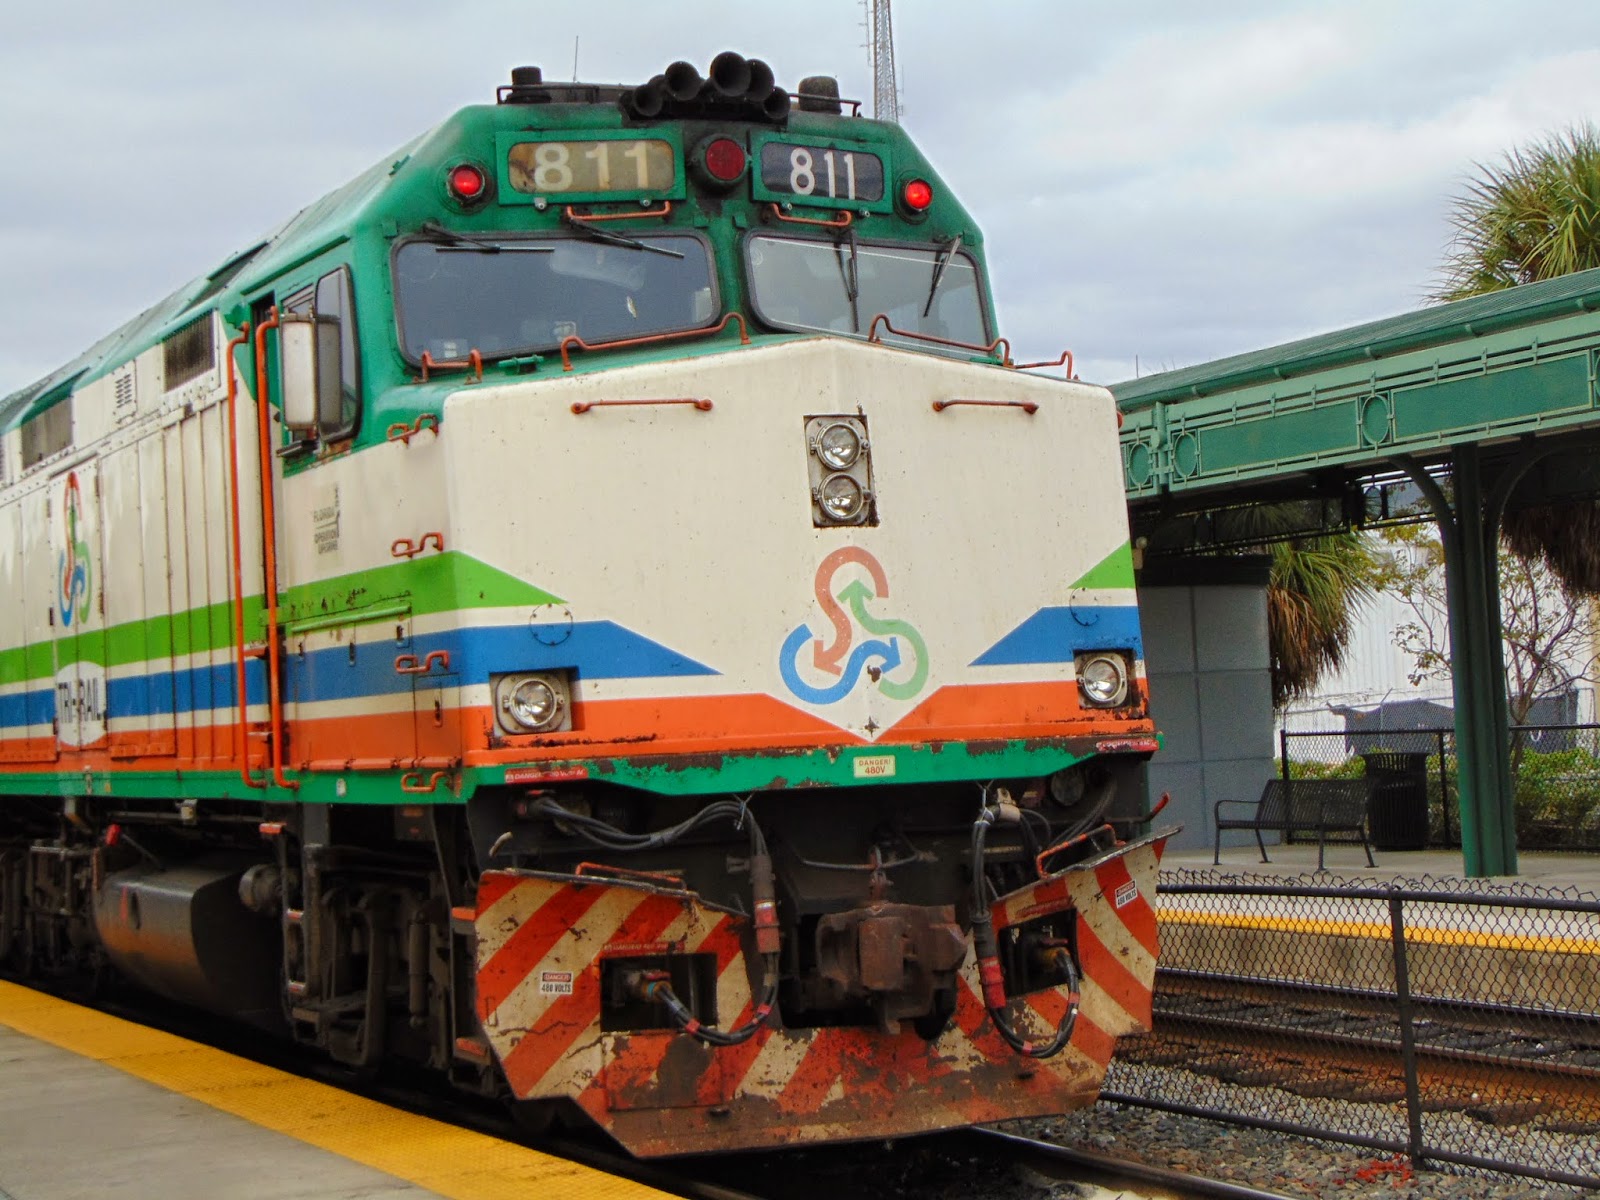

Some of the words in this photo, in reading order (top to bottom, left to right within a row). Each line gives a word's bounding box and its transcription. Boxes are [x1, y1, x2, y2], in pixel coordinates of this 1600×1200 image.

[534, 142, 649, 190] 811
[789, 147, 855, 200] 811
[58, 678, 103, 723] TRI-RAIL
[859, 758, 891, 766] DANGER!
[865, 766, 886, 774] 480V
[542, 983, 553, 993] 480
[554, 983, 571, 993] VOLTS
